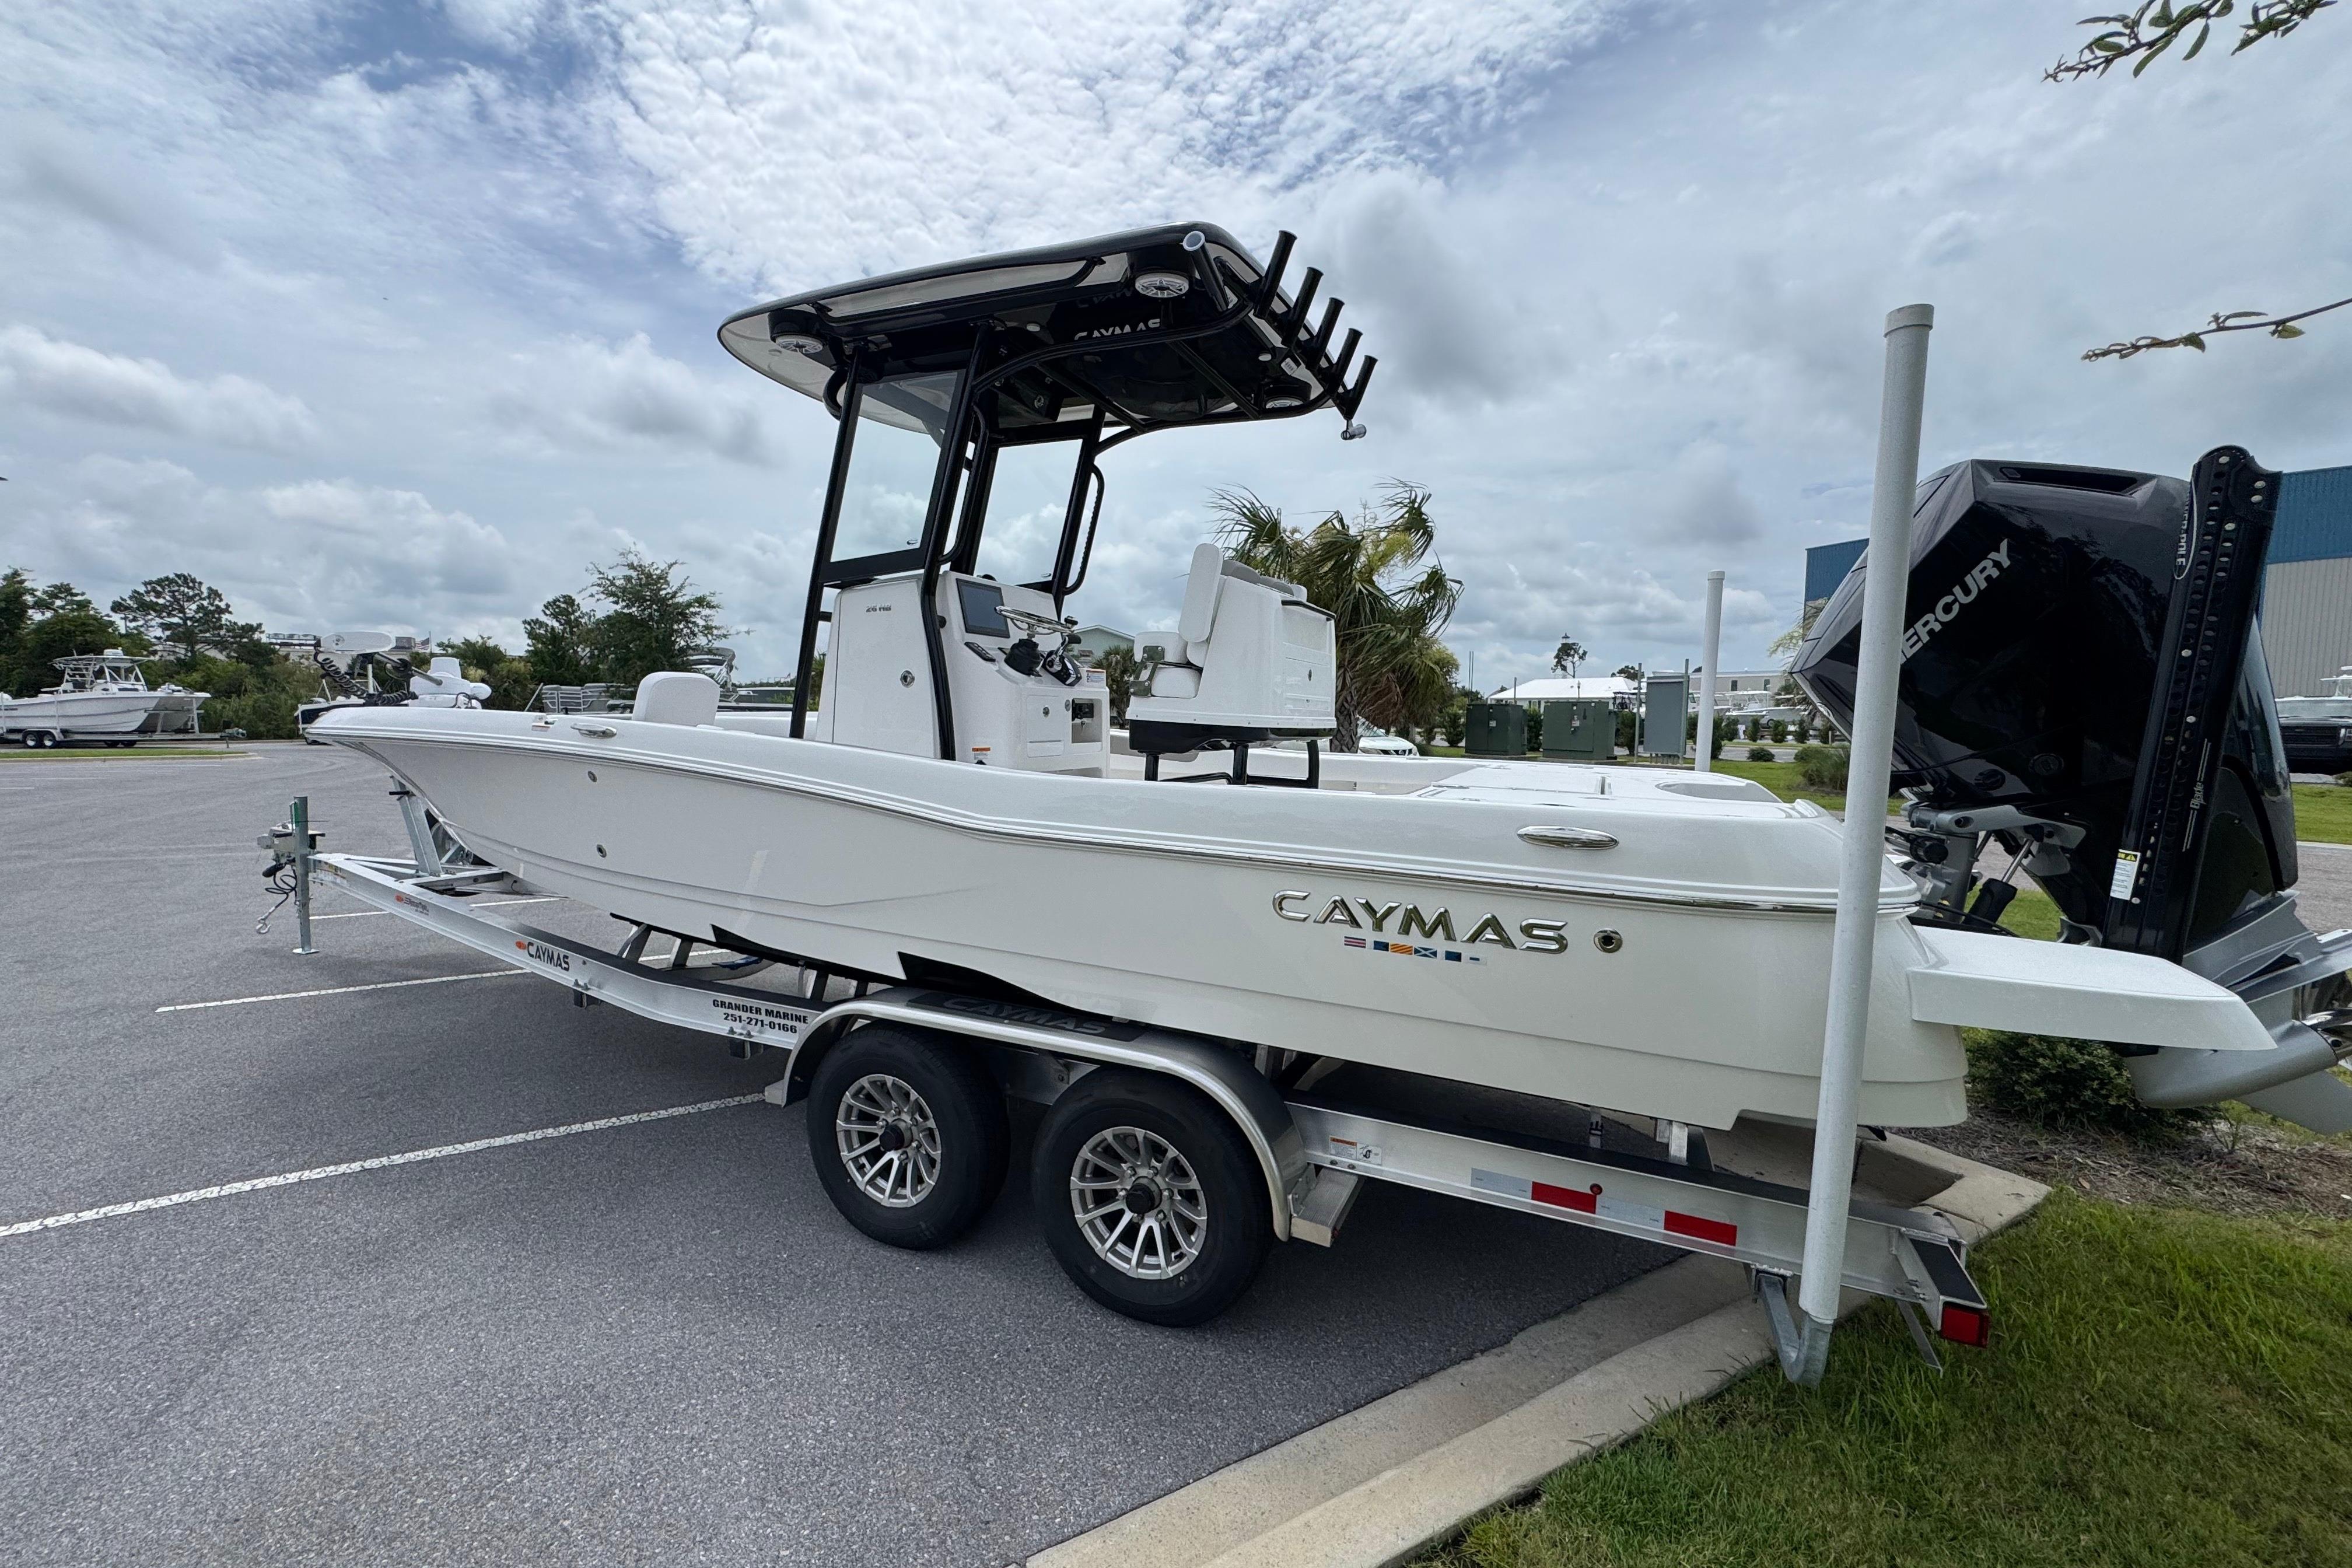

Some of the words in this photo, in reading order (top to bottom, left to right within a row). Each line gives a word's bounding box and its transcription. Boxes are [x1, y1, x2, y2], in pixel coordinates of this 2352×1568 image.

[1900, 538, 2011, 664] ERCURY
[1272, 889, 1569, 954] CAYMAS
[527, 941, 570, 972] CAYMAS
[712, 999, 762, 1016] GRANDER
[765, 1009, 809, 1024] MARINE
[723, 1012, 797, 1034] 251-271-0166
[943, 997, 1107, 1034] CAYMAS
